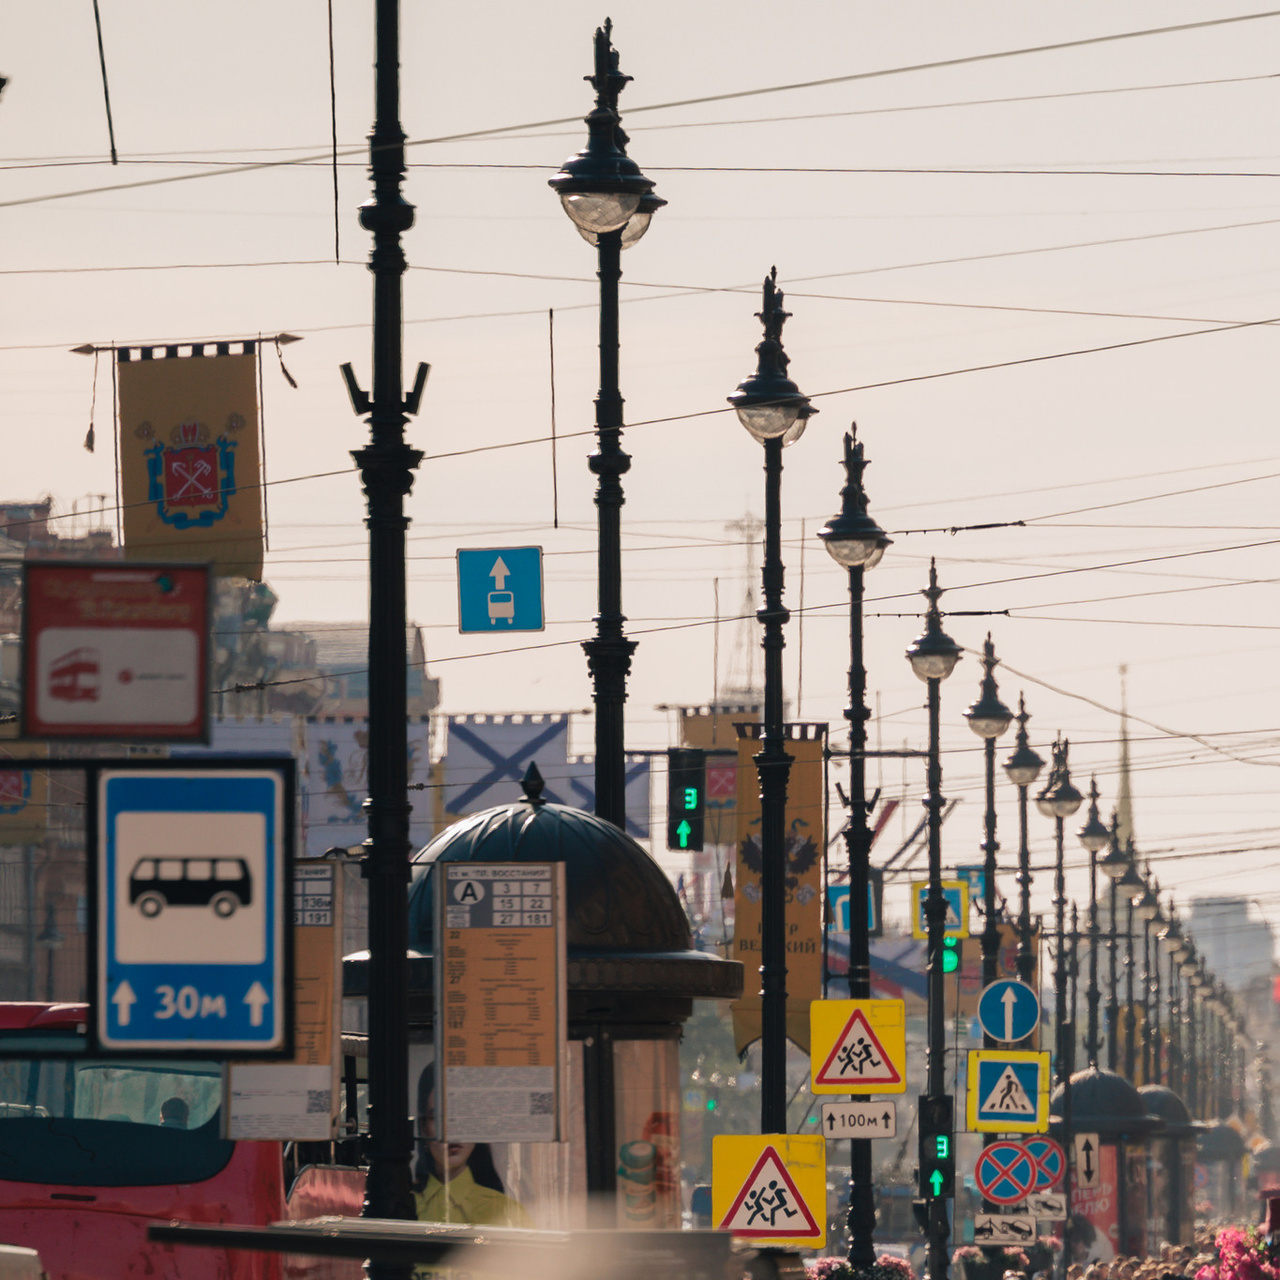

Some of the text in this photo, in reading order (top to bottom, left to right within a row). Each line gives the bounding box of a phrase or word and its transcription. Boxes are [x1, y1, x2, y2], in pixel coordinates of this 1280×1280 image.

[684, 787, 697, 810] 3
[503, 883, 540, 894] 3 7
[500, 899, 544, 909] 15 22
[308, 913, 328, 923] 191
[500, 914, 548, 925] 27 181
[154, 985, 227, 1019] 30м
[840, 1114, 878, 1127] 100м
[936, 1134, 949, 1159] 3
